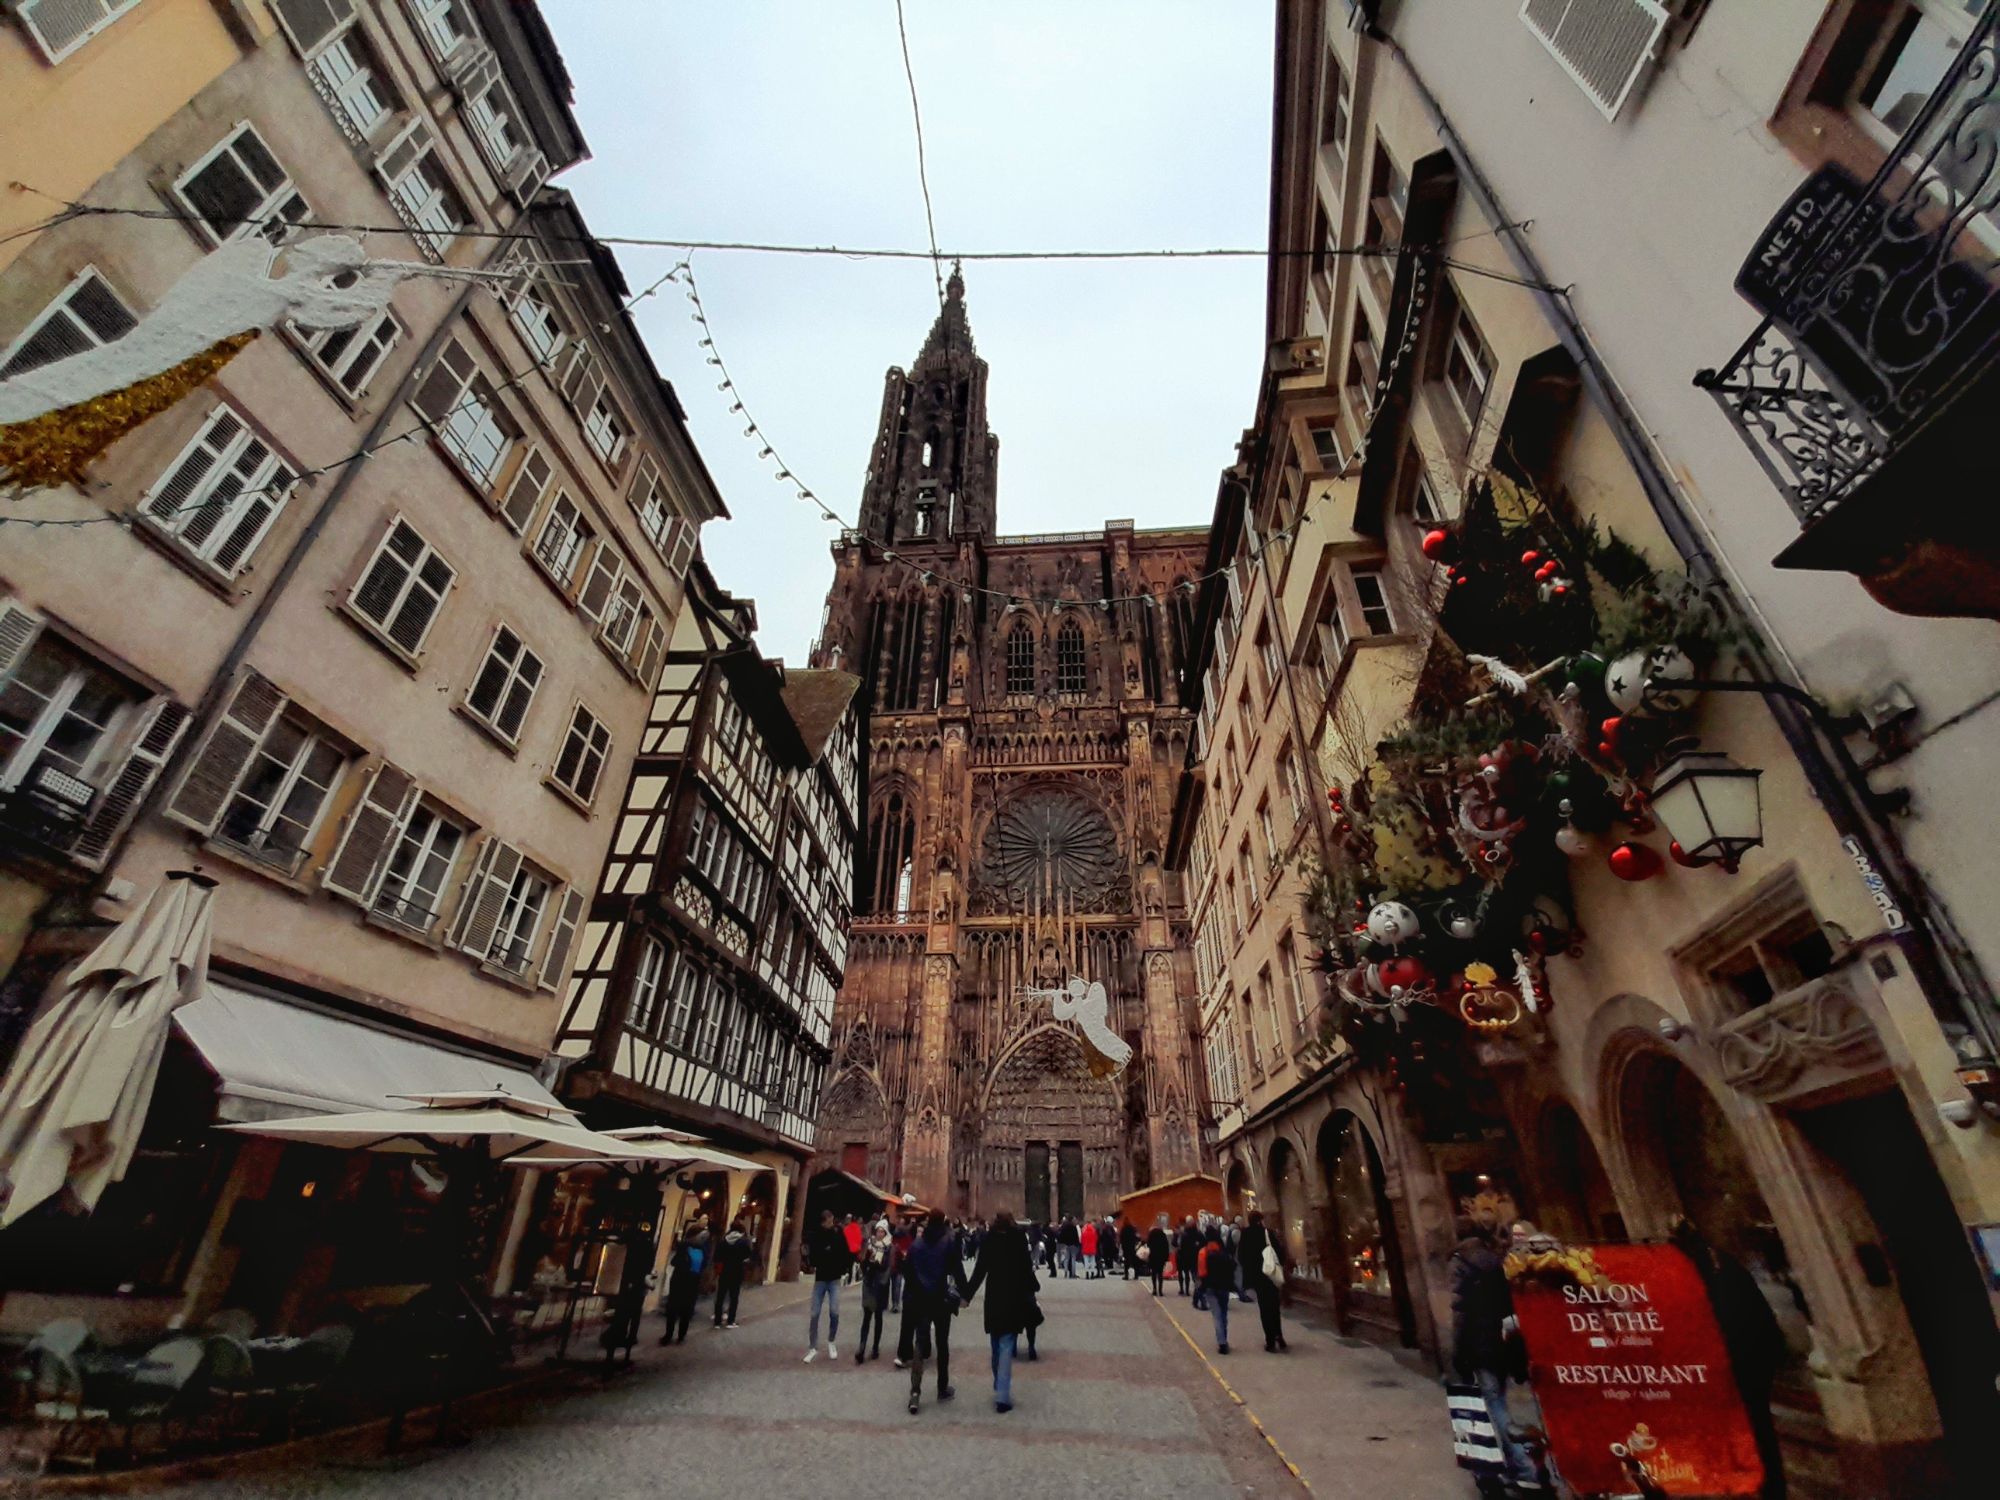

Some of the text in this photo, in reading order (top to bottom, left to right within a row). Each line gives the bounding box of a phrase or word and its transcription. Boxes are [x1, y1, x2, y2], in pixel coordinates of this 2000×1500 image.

[1562, 1283, 1649, 1304] SALON
[1567, 1307, 1664, 1332] DE THÉ
[1554, 1364, 1708, 1384] RESTAURANT
